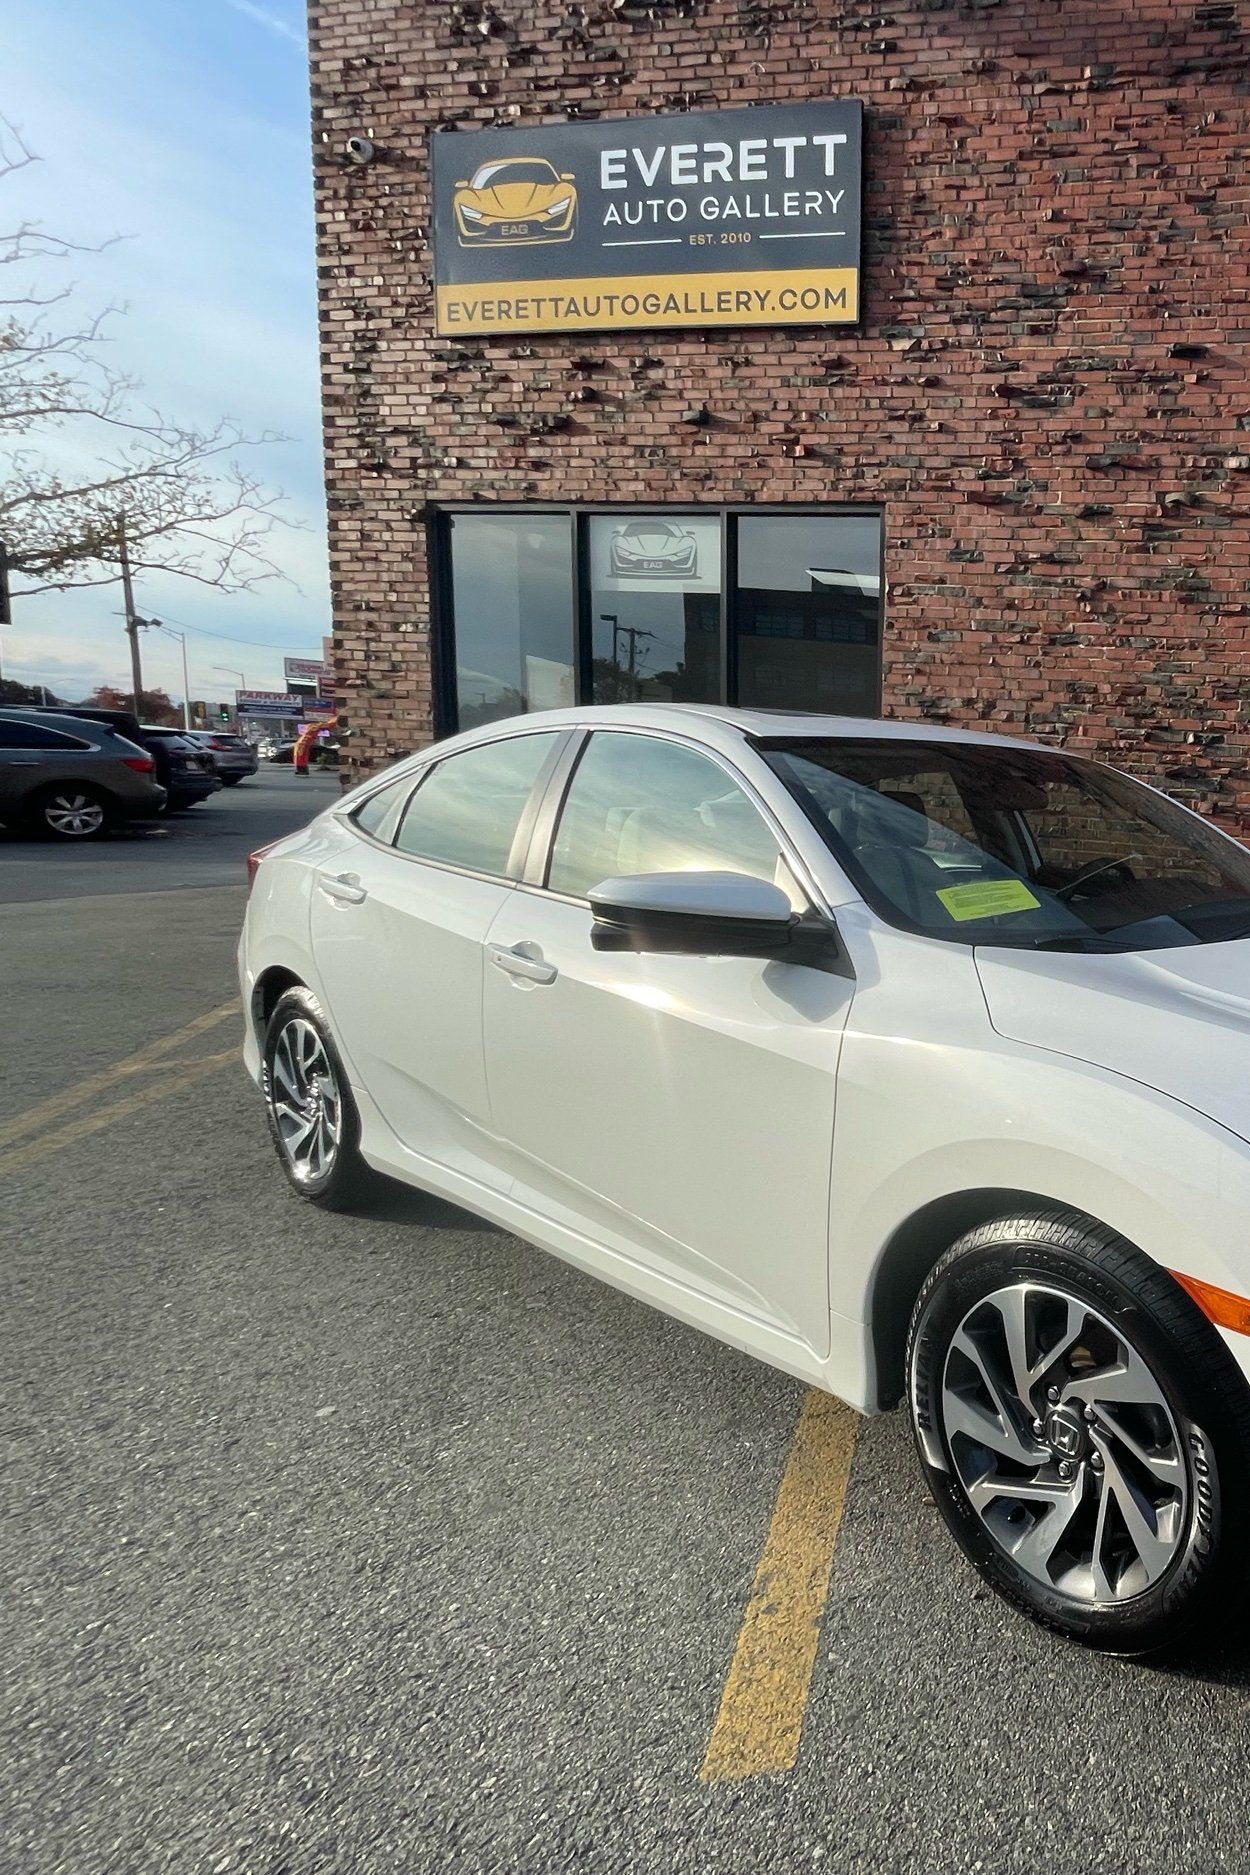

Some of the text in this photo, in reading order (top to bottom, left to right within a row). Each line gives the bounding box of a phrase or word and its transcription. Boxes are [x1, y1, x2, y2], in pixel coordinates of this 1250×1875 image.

[601, 134, 847, 190] EVERETT
[603, 190, 846, 226] AUTO GALLERY
[501, 224, 529, 236] EAG
[720, 232, 752, 244] 2010
[447, 287, 847, 322] EVERETTAUTOGALLERY.COM
[643, 561, 664, 569] EAG
[240, 691, 301, 702] PARKWAY
